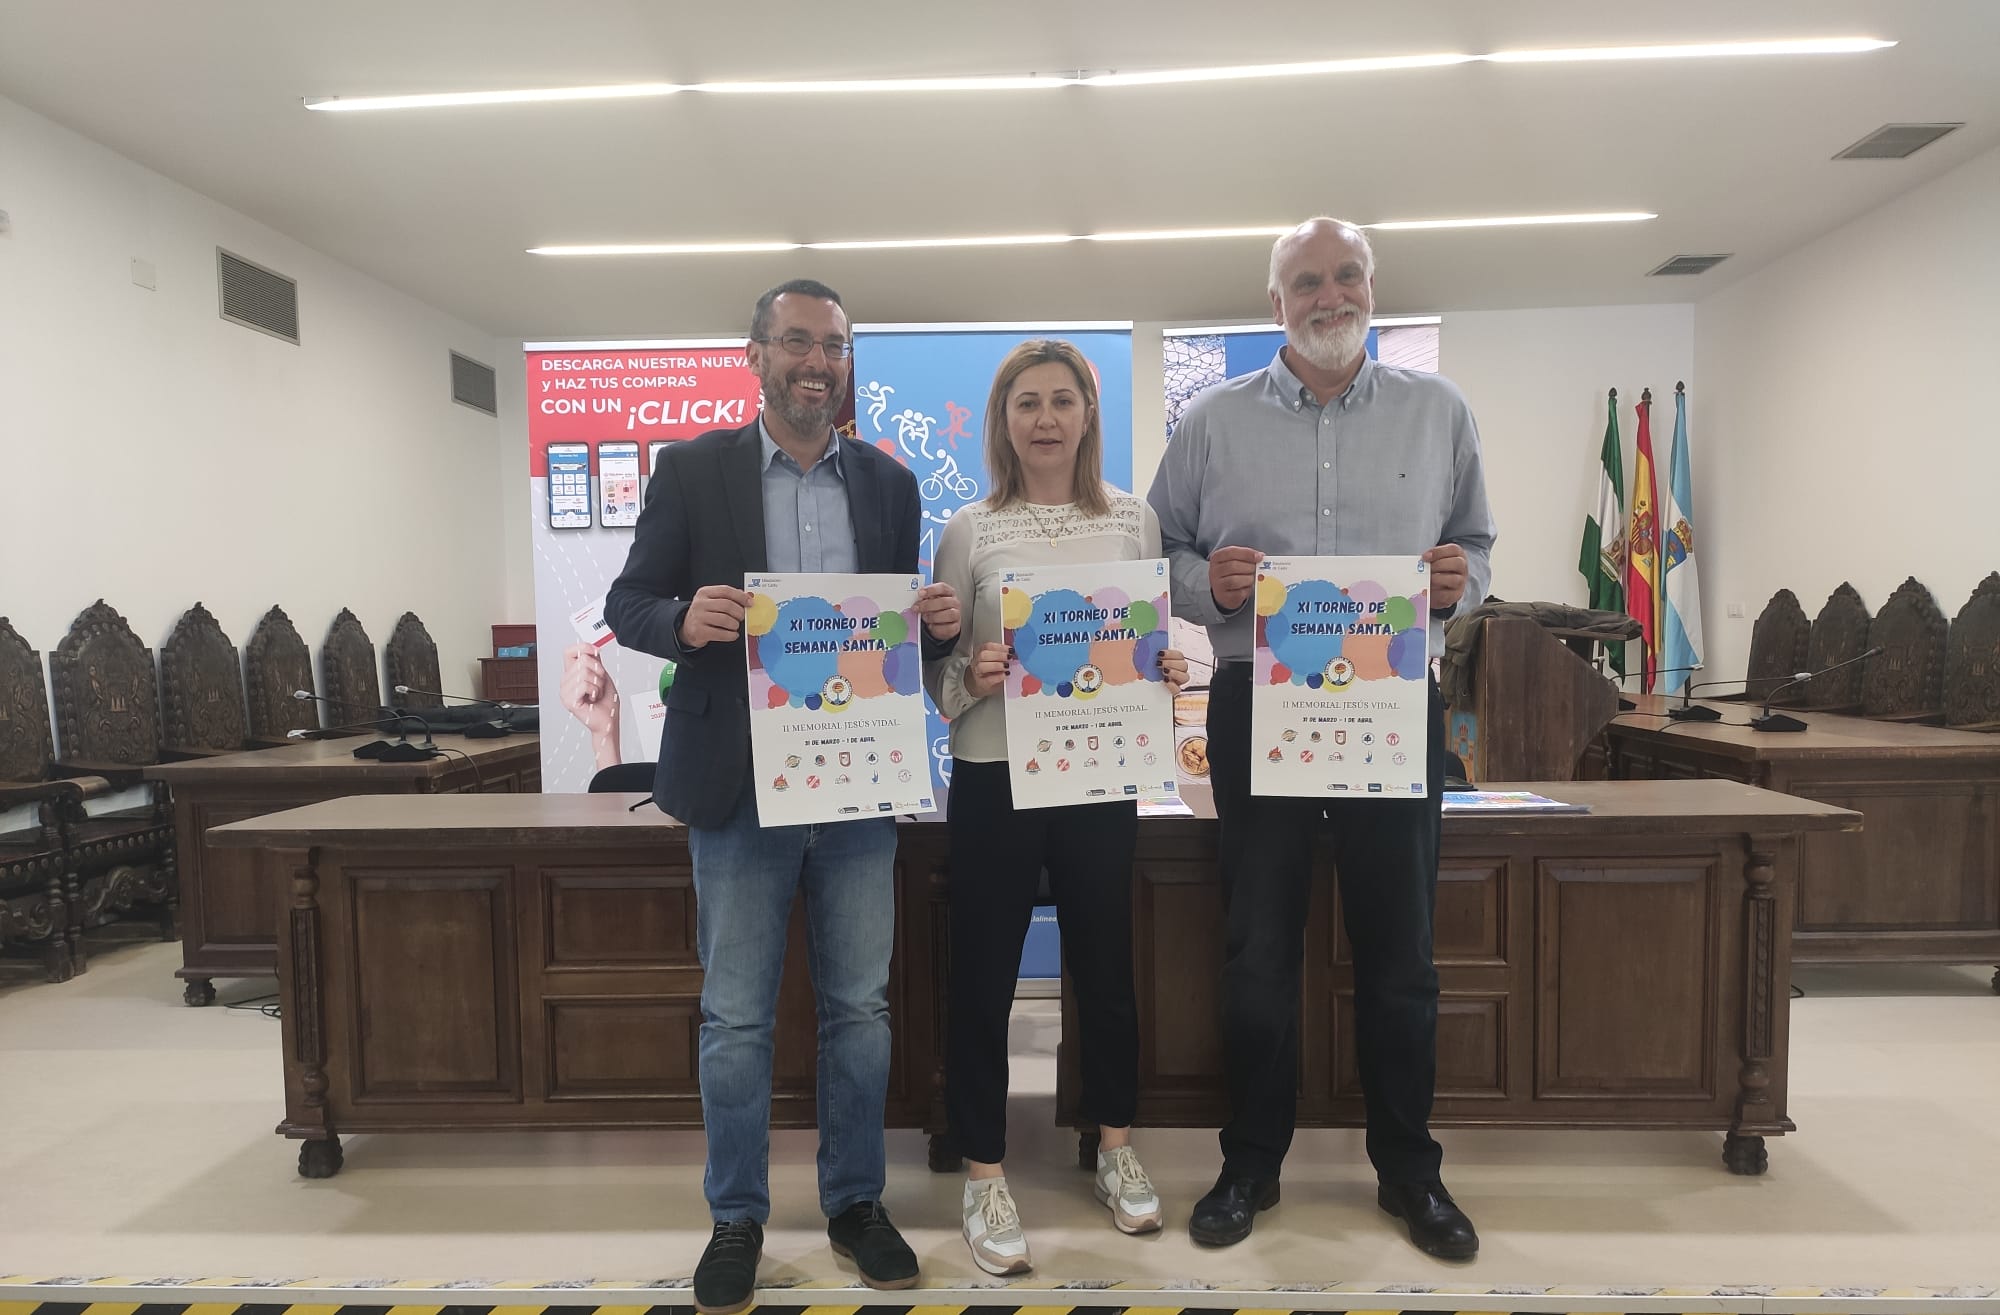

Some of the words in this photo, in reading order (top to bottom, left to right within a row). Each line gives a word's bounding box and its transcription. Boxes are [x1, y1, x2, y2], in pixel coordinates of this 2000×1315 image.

[541, 358, 624, 371] DESCARGA
[628, 357, 697, 370] NUESTRA
[541, 379, 551, 392] y
[555, 378, 586, 390] HAZ
[590, 377, 618, 389] TUS
[622, 376, 697, 388] COMPRAS
[540, 399, 586, 414] CON
[592, 398, 621, 413] UN
[627, 399, 745, 430] ¡CLICK!
[1297, 601, 1310, 613] XI
[1314, 601, 1364, 613] TORNEO
[1368, 601, 1386, 613] DE
[1044, 612, 1056, 624] XI
[1060, 608, 1108, 622] TORNEO
[1113, 606, 1129, 619] DE
[790, 618, 803, 632] XI
[807, 617, 858, 630] TORNEO
[862, 616, 878, 629] DE
[1291, 623, 1344, 635] SEMANA
[1038, 631, 1091, 645] SEMANA
[785, 640, 839, 654] SEMANA
[1043, 708, 1091, 718] MEMORIAL
[1093, 704, 1118, 716] JESÚS
[1282, 701, 1289, 709] II
[1291, 701, 1341, 709] MEMORIAL
[1343, 699, 1369, 710] JESÚS
[792, 722, 842, 732] MEMORIAL
[844, 719, 870, 731] JESÚS
